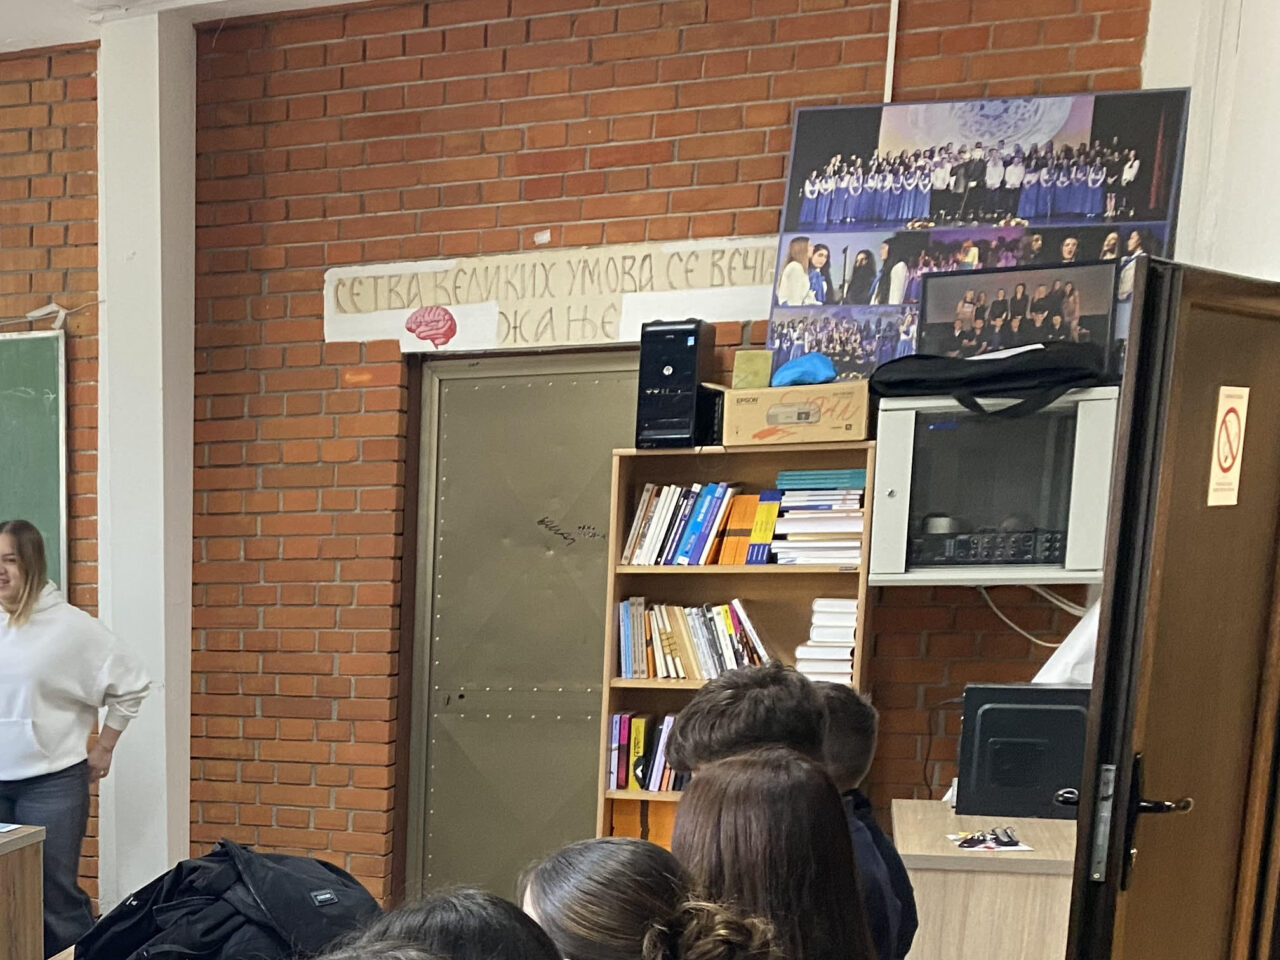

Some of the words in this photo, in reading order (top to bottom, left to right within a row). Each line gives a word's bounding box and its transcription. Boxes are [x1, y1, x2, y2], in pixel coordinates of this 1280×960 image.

[334, 273, 424, 314] СЕТВА
[433, 262, 557, 306] ВЕЛИКИХ
[567, 253, 654, 296] УМОВА
[666, 250, 699, 290] СЕ
[498, 302, 618, 343] ЖАЊЕ
